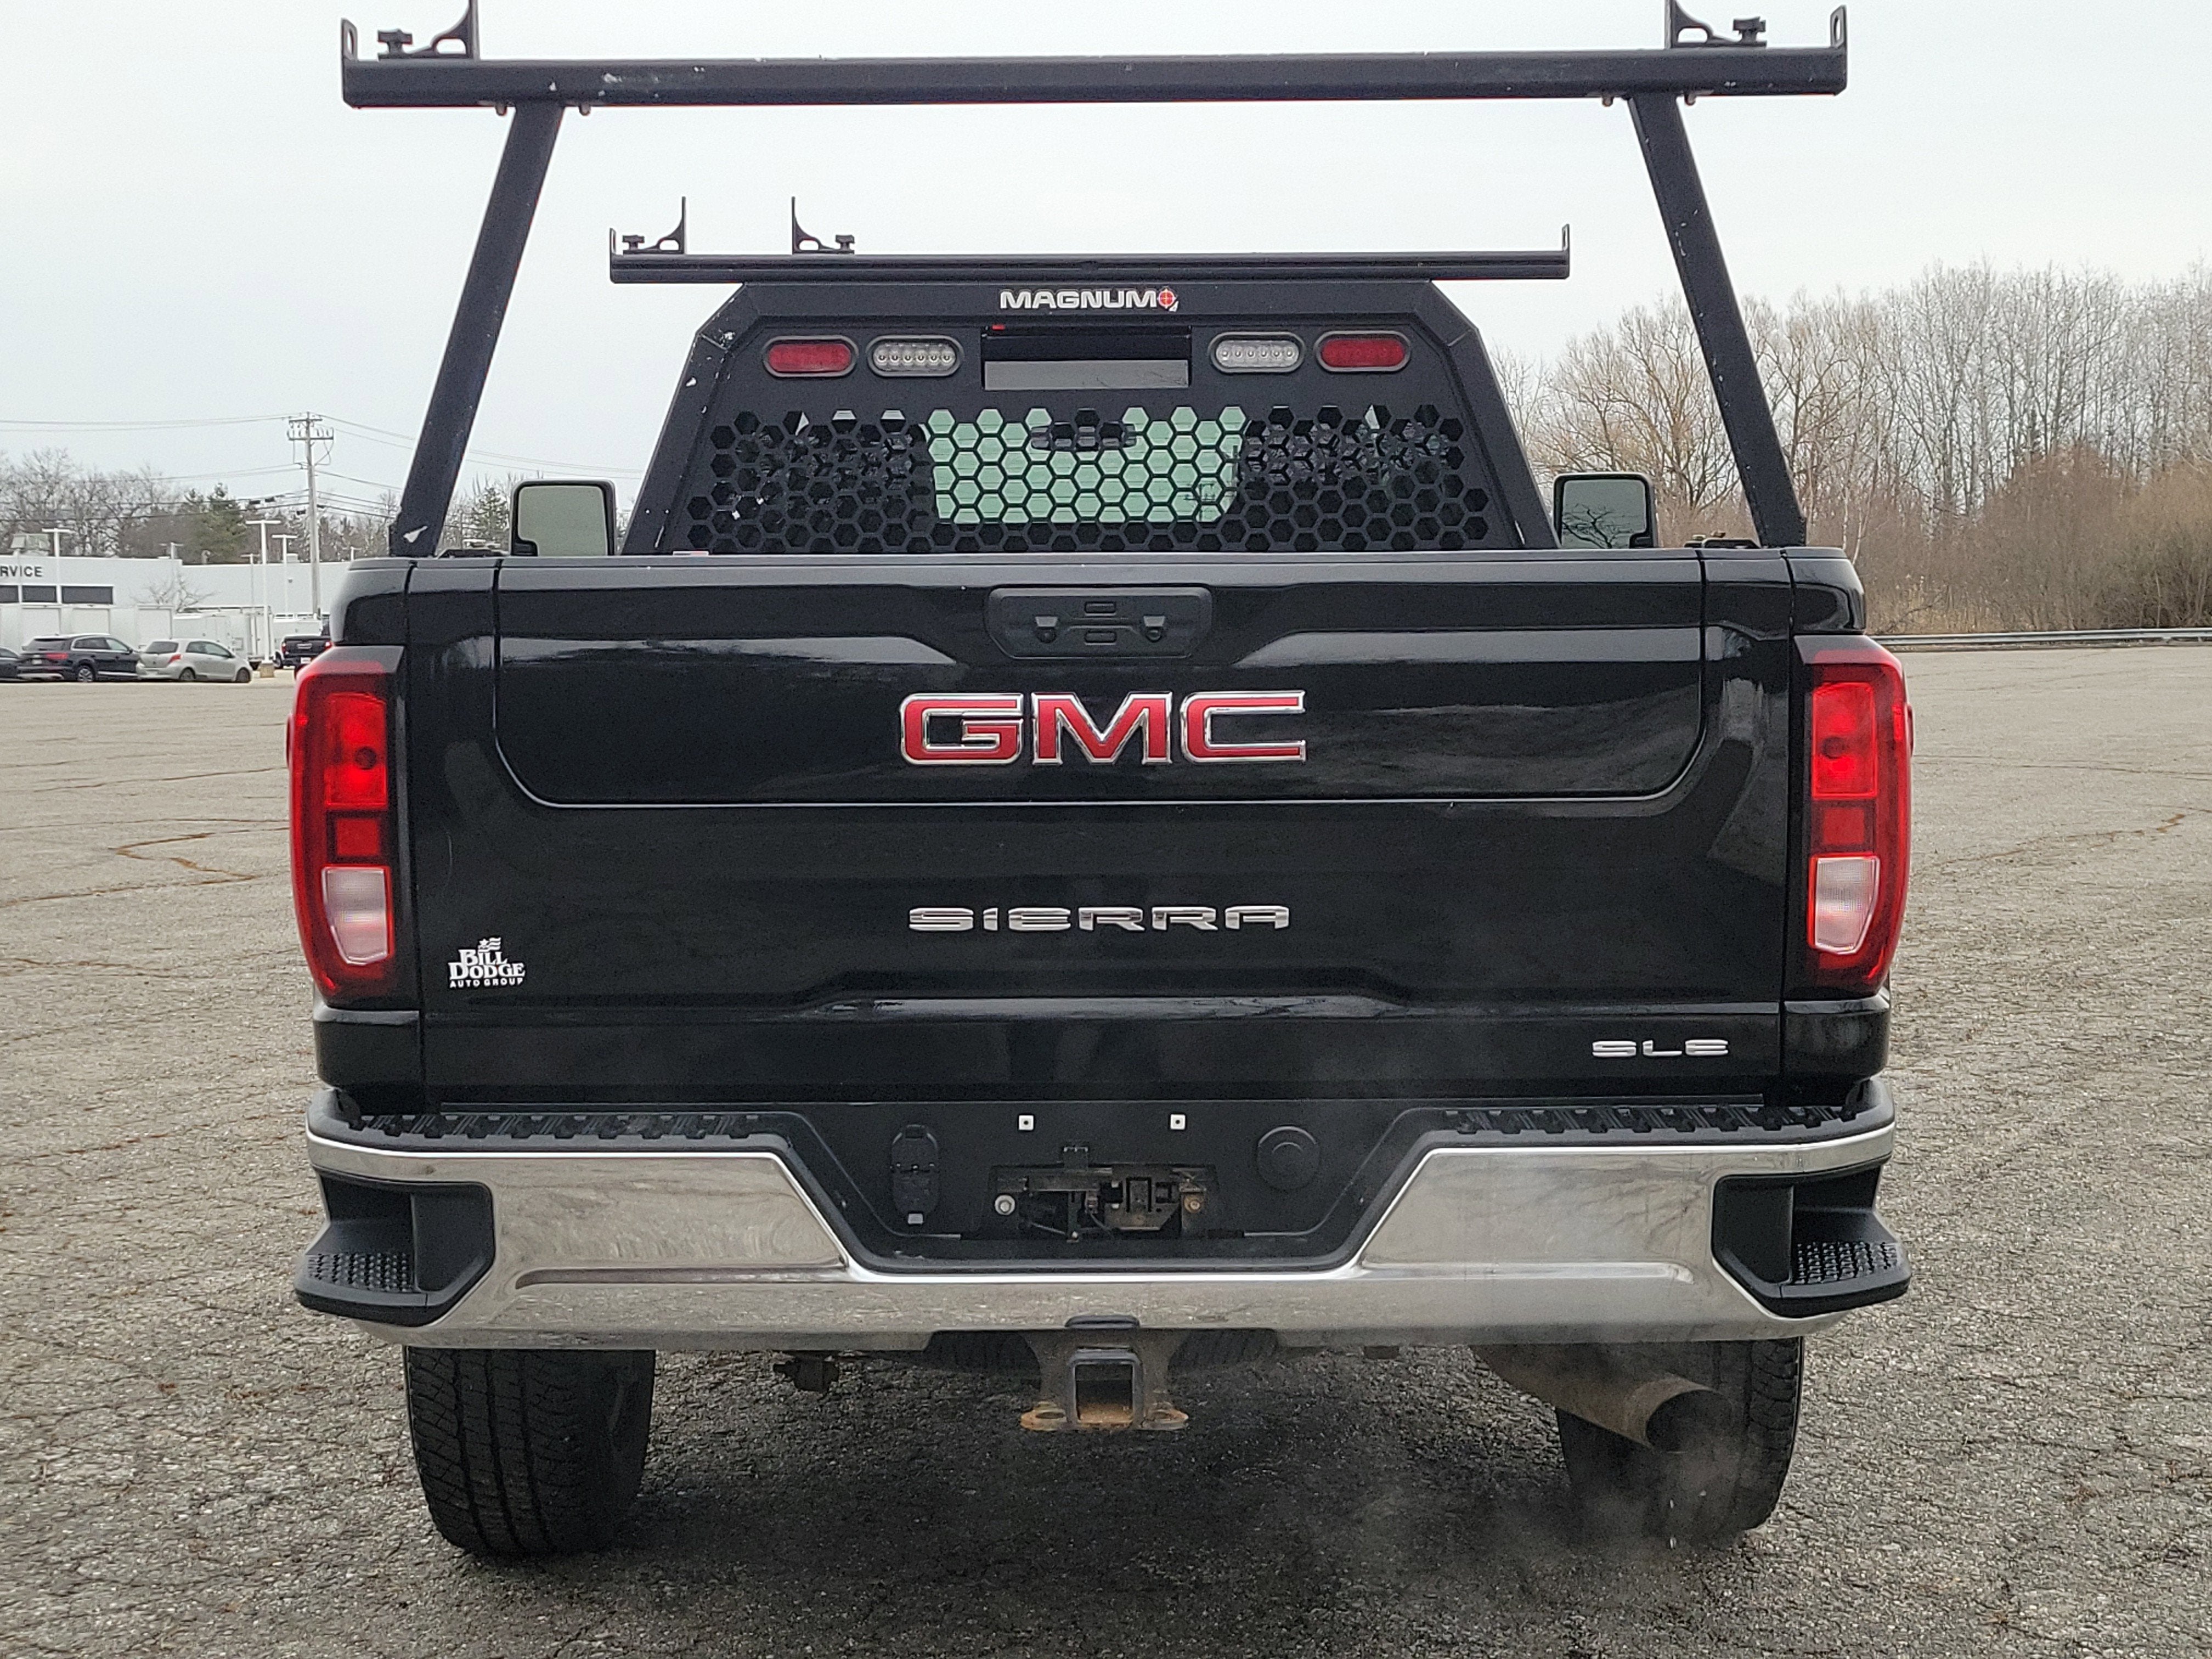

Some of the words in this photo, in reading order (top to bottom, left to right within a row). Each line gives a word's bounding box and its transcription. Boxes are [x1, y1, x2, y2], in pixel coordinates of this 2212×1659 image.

[1000, 290, 1156, 309] MAGNUM
[0, 566, 43, 577] RVICE
[899, 691, 1306, 765] GMC
[909, 905, 1290, 931] SIERRA
[458, 949, 508, 966] BILL
[448, 962, 526, 980] DODGE
[450, 979, 480, 988] AUTO
[484, 978, 523, 987] GROUP
[1592, 1039, 1729, 1057] SLE
